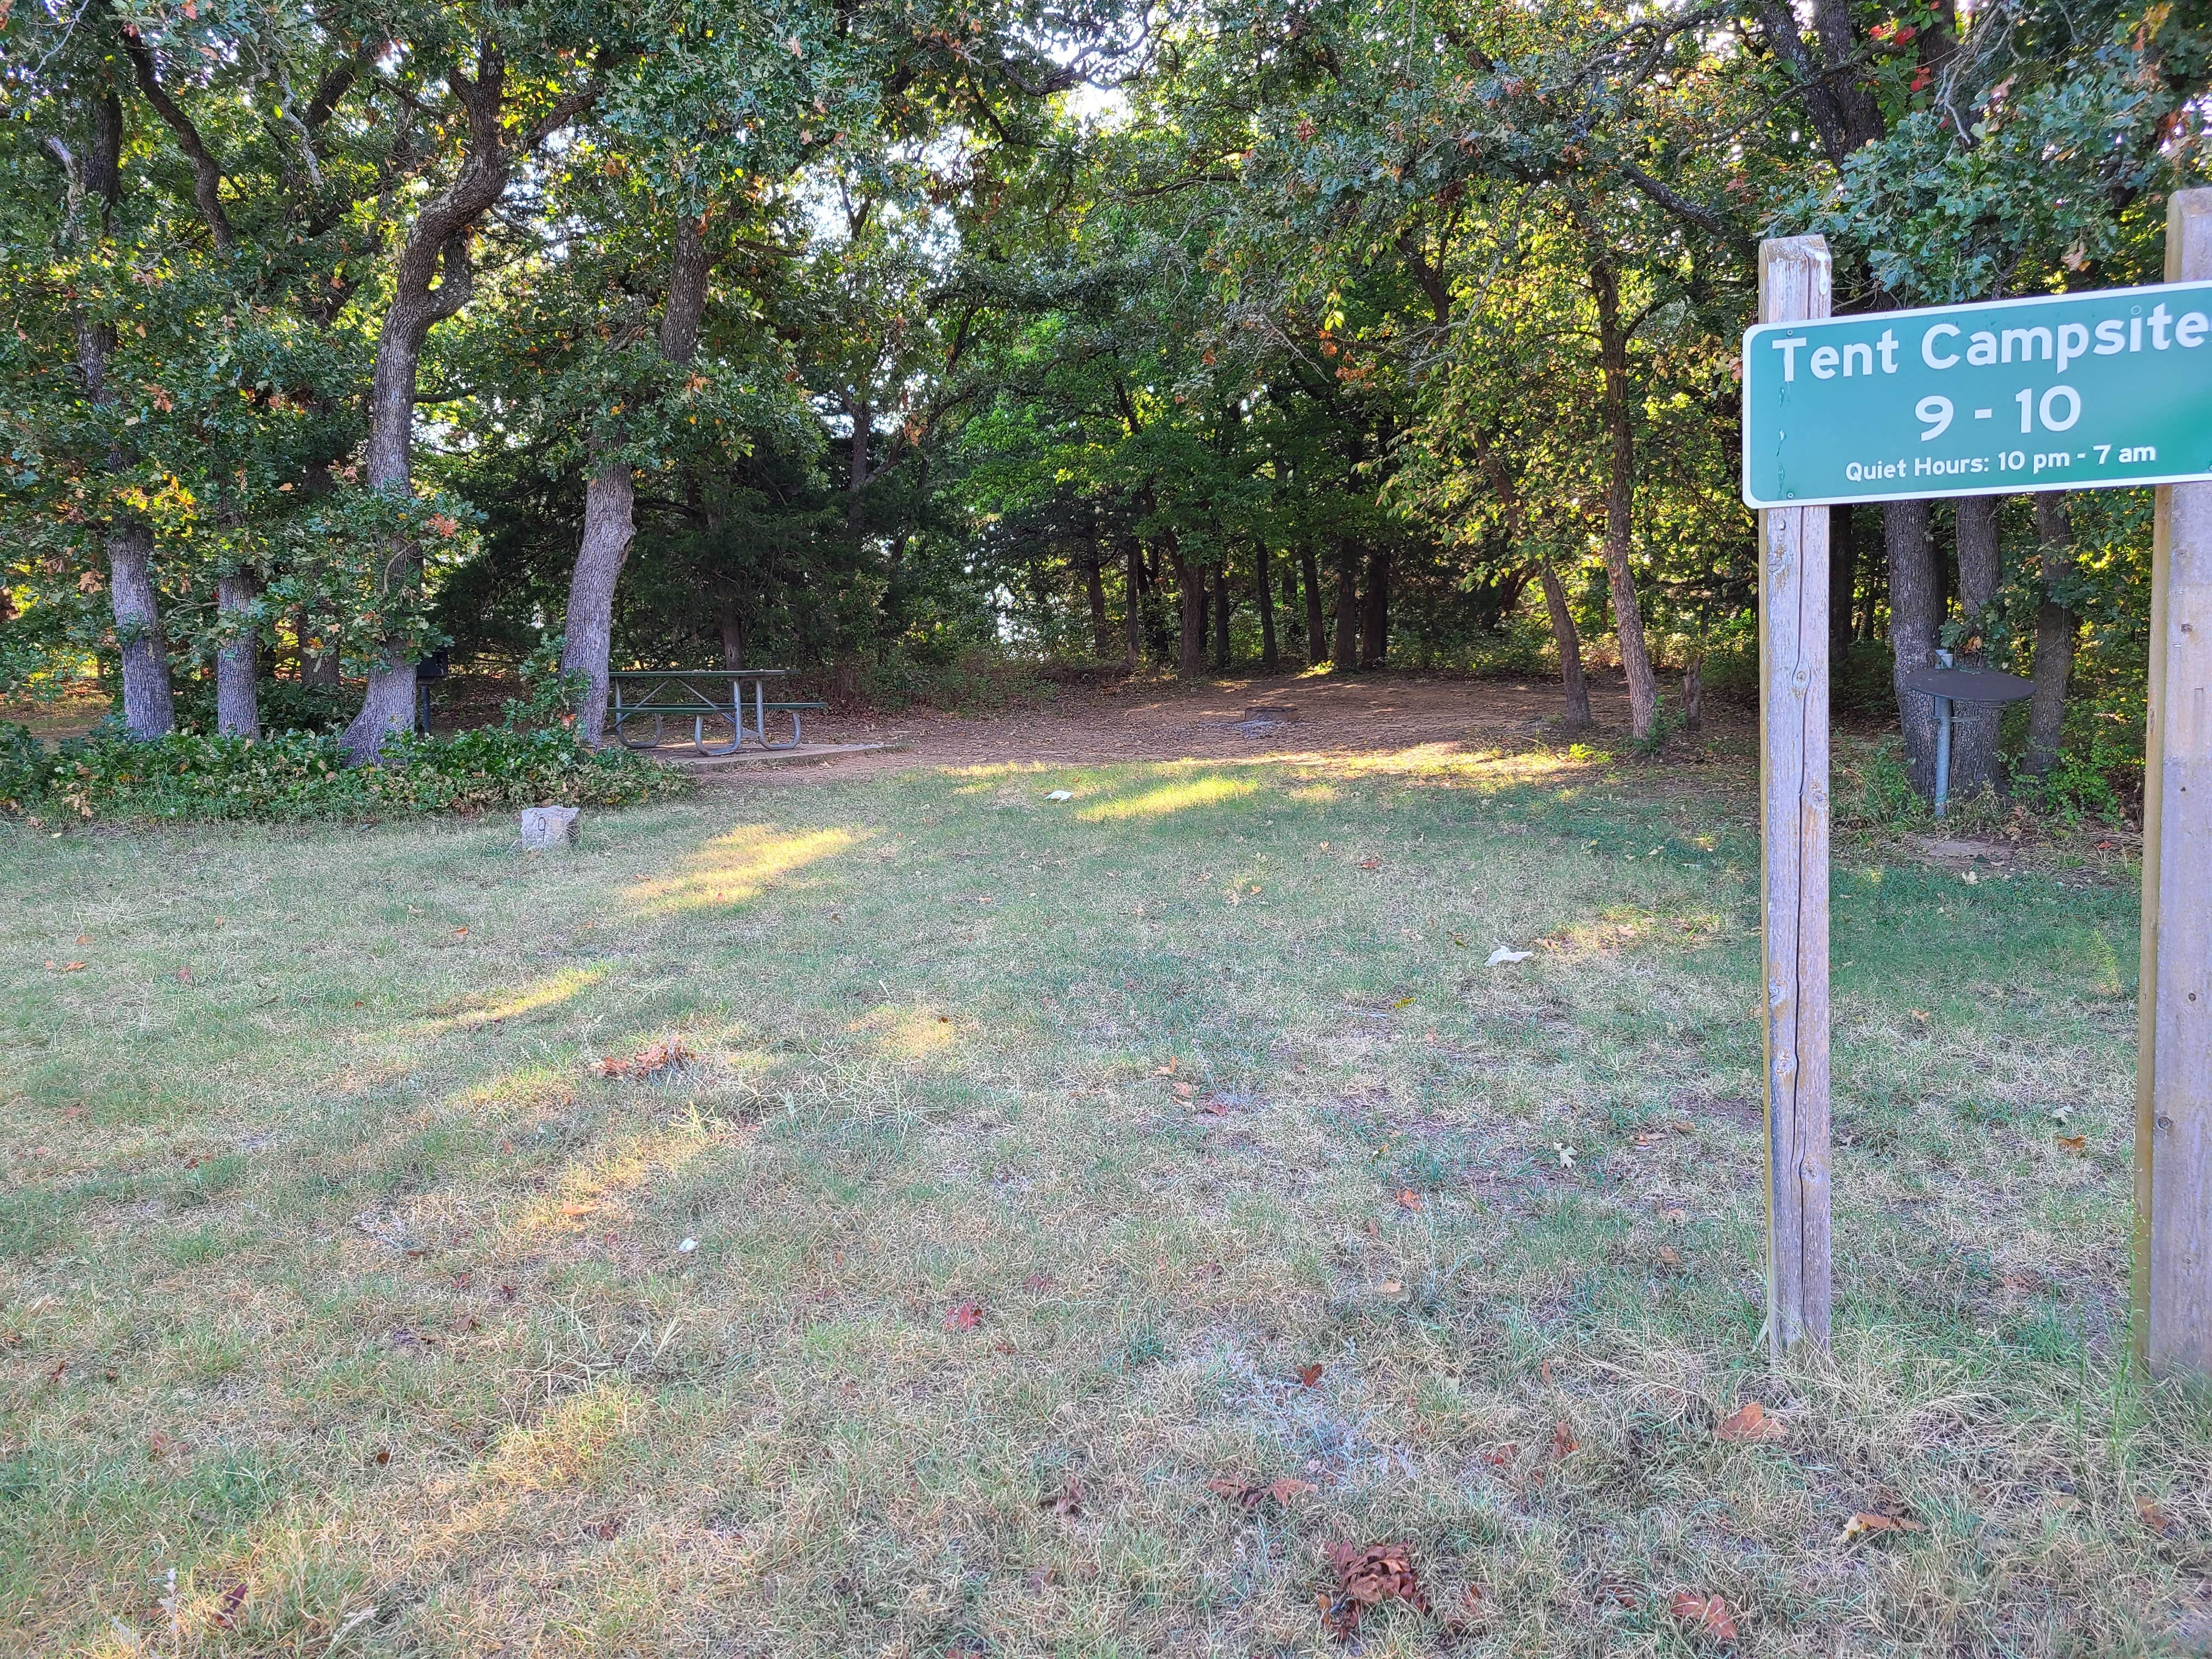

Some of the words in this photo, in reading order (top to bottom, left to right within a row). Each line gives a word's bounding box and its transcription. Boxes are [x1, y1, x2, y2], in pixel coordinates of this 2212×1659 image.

[1771, 329, 1899, 382] Tent
[1921, 302, 2212, 374] Campsite
[1915, 396, 1954, 441] 9
[1974, 408, 1992, 419] -
[2015, 385, 2081, 433] 10
[1845, 461, 1907, 482] Quiet
[1914, 456, 1989, 477] Hours:
[1998, 450, 2026, 471] 10
[2033, 453, 2070, 474] pm
[2092, 444, 2112, 464] 7
[2118, 445, 2157, 463] am
